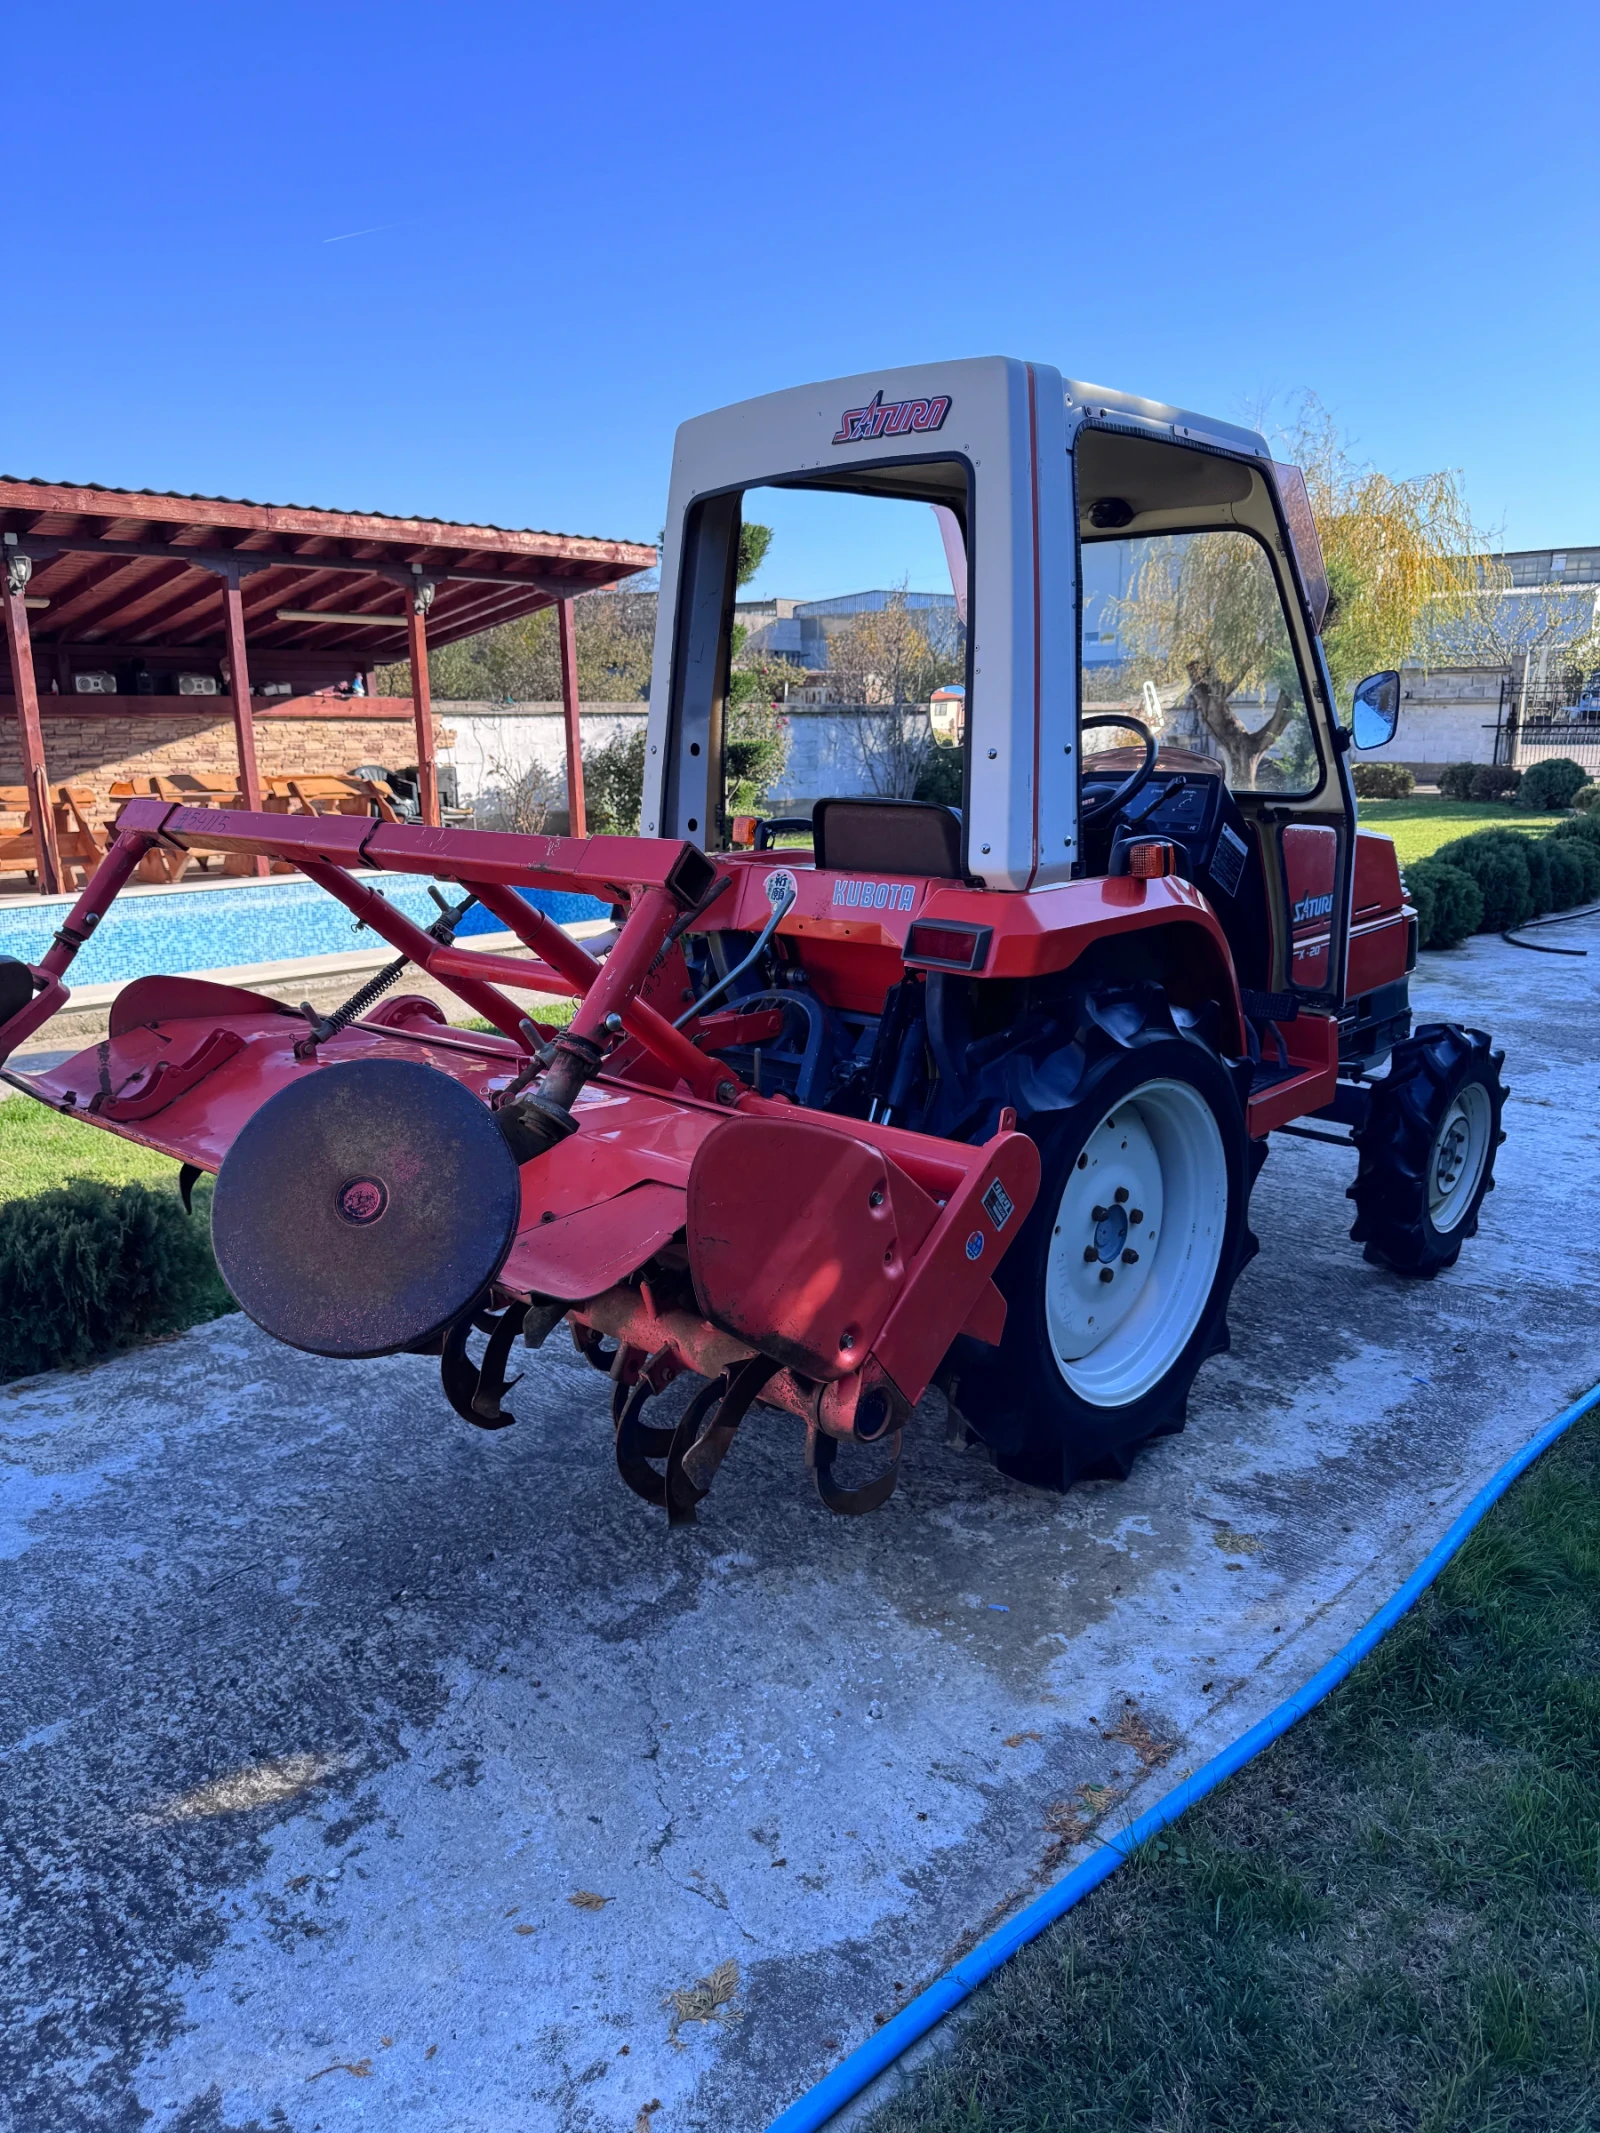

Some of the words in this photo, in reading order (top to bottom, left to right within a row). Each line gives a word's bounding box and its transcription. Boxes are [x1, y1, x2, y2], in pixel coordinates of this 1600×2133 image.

[832, 390, 952, 444] SATURN
[176, 810, 230, 834] #54115
[832, 879, 916, 912] KUBOTA
